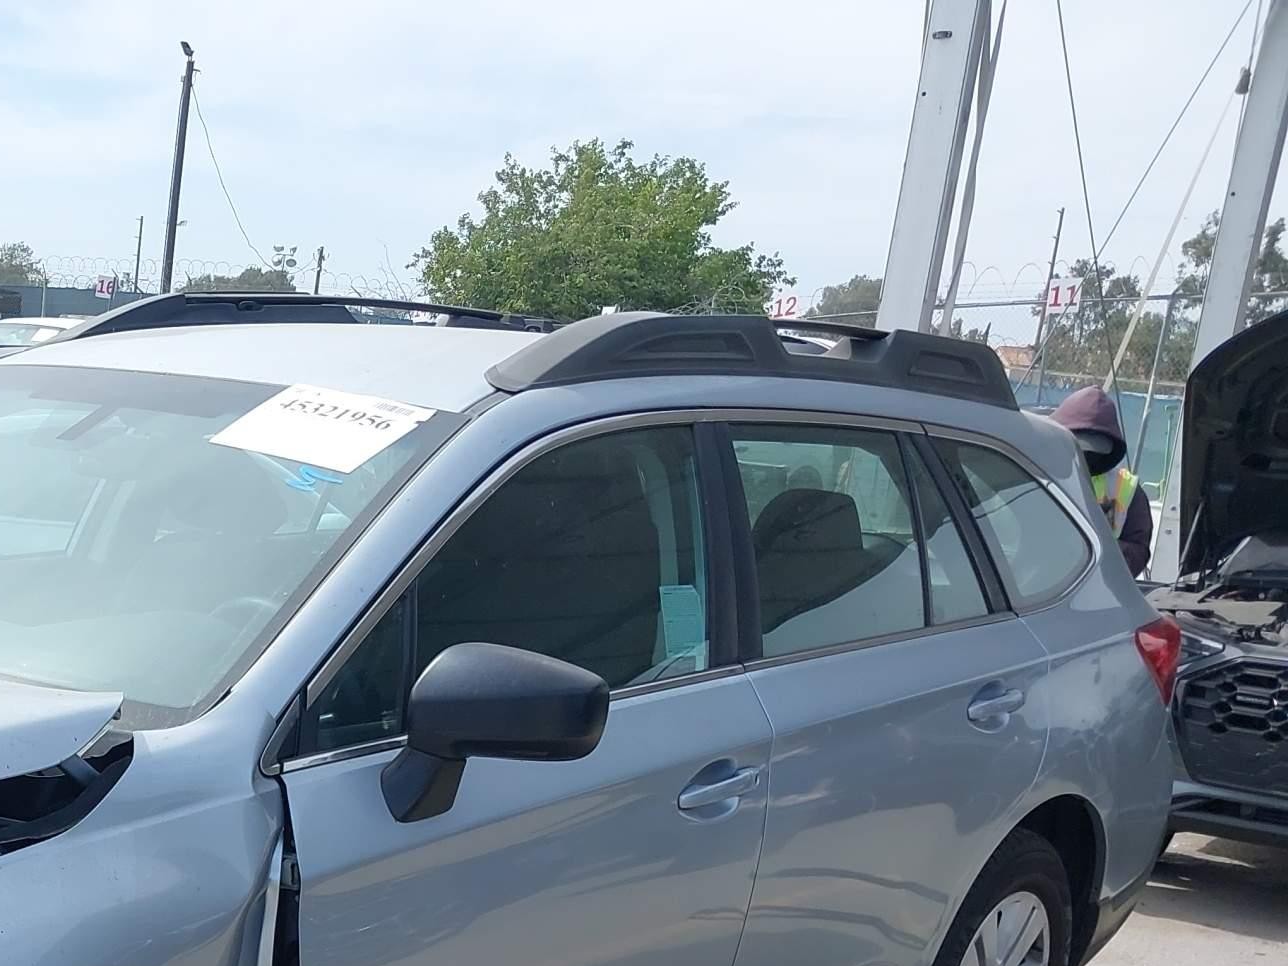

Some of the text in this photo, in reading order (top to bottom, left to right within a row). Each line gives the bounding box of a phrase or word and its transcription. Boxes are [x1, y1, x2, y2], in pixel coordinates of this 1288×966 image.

[97, 279, 114, 295] 16
[1048, 285, 1078, 307] 11
[773, 296, 797, 318] 12
[279, 399, 394, 430] 45321956
